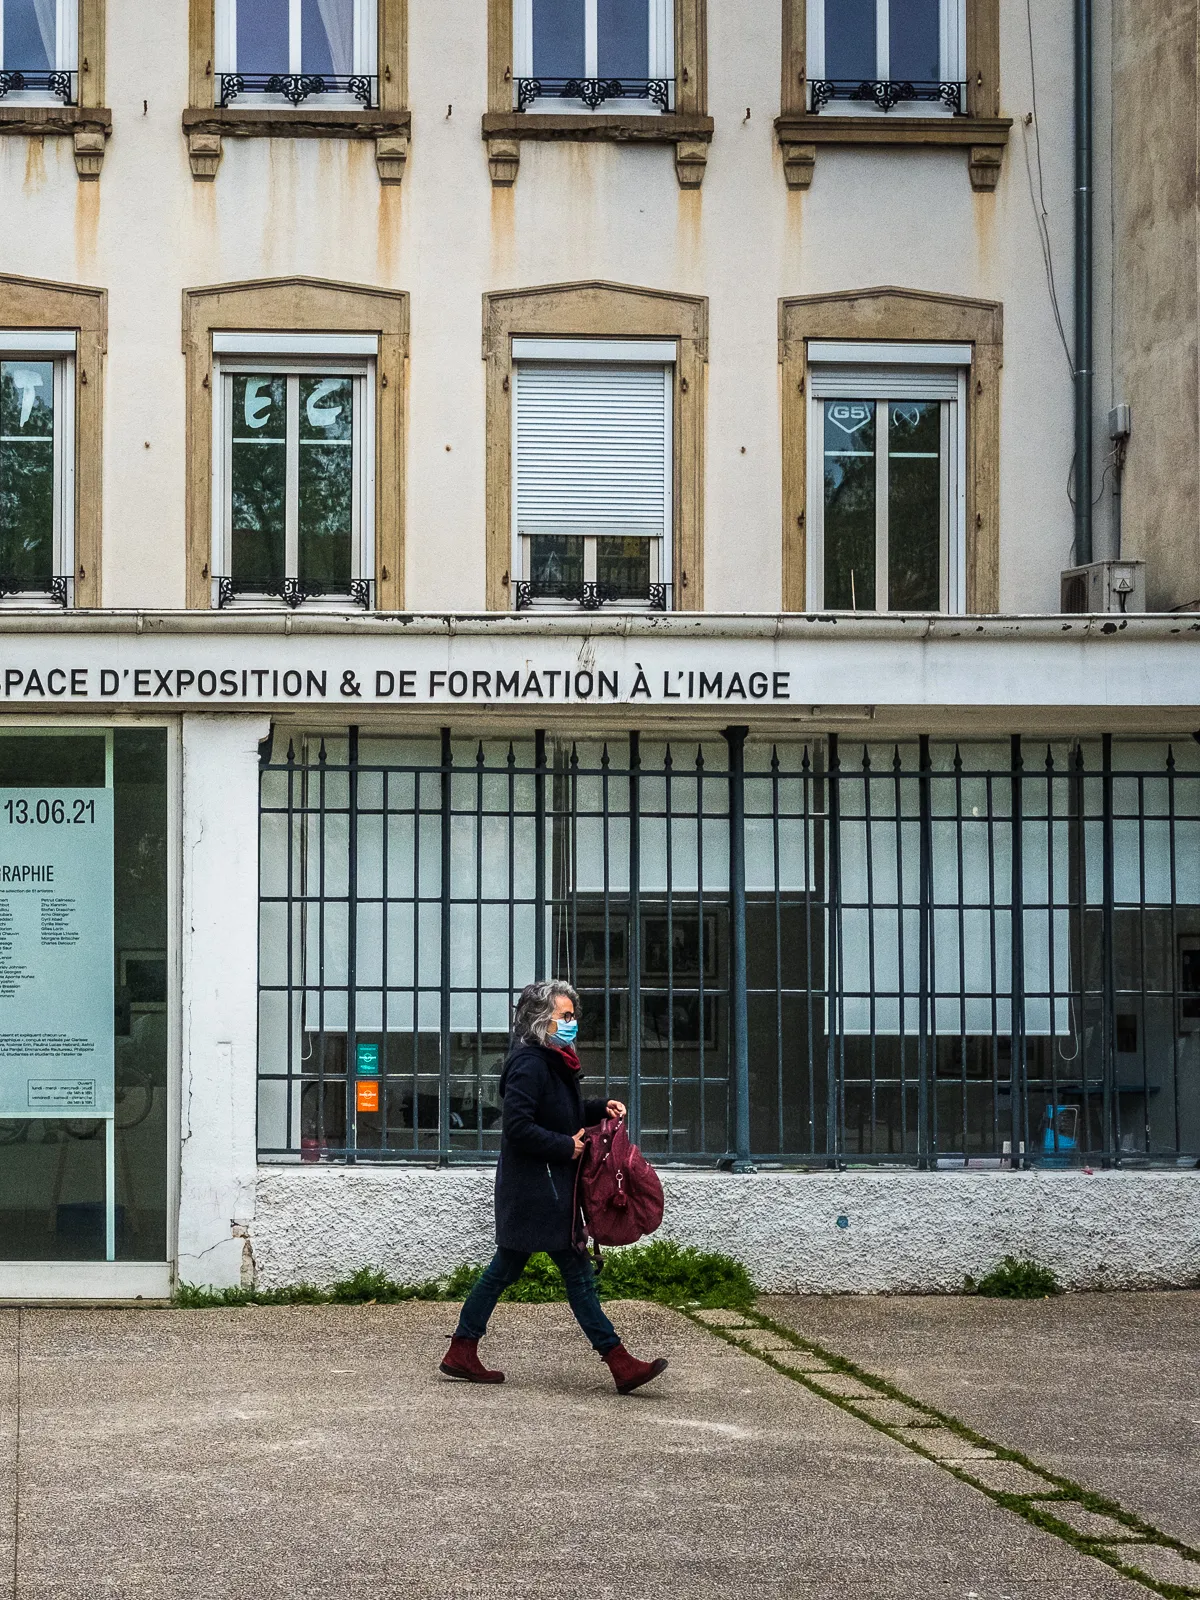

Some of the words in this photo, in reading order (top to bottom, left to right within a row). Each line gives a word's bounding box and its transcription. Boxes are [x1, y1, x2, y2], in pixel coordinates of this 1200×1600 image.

[833, 406, 865, 419] G5
[100, 669, 327, 697] D'EXPOSITION
[340, 669, 362, 697] &
[376, 670, 417, 697] DE
[429, 670, 618, 699] FORMATION
[630, 662, 652, 698] À
[663, 671, 790, 699] L'IMAGE
[3, 799, 95, 825] 13.06.21
